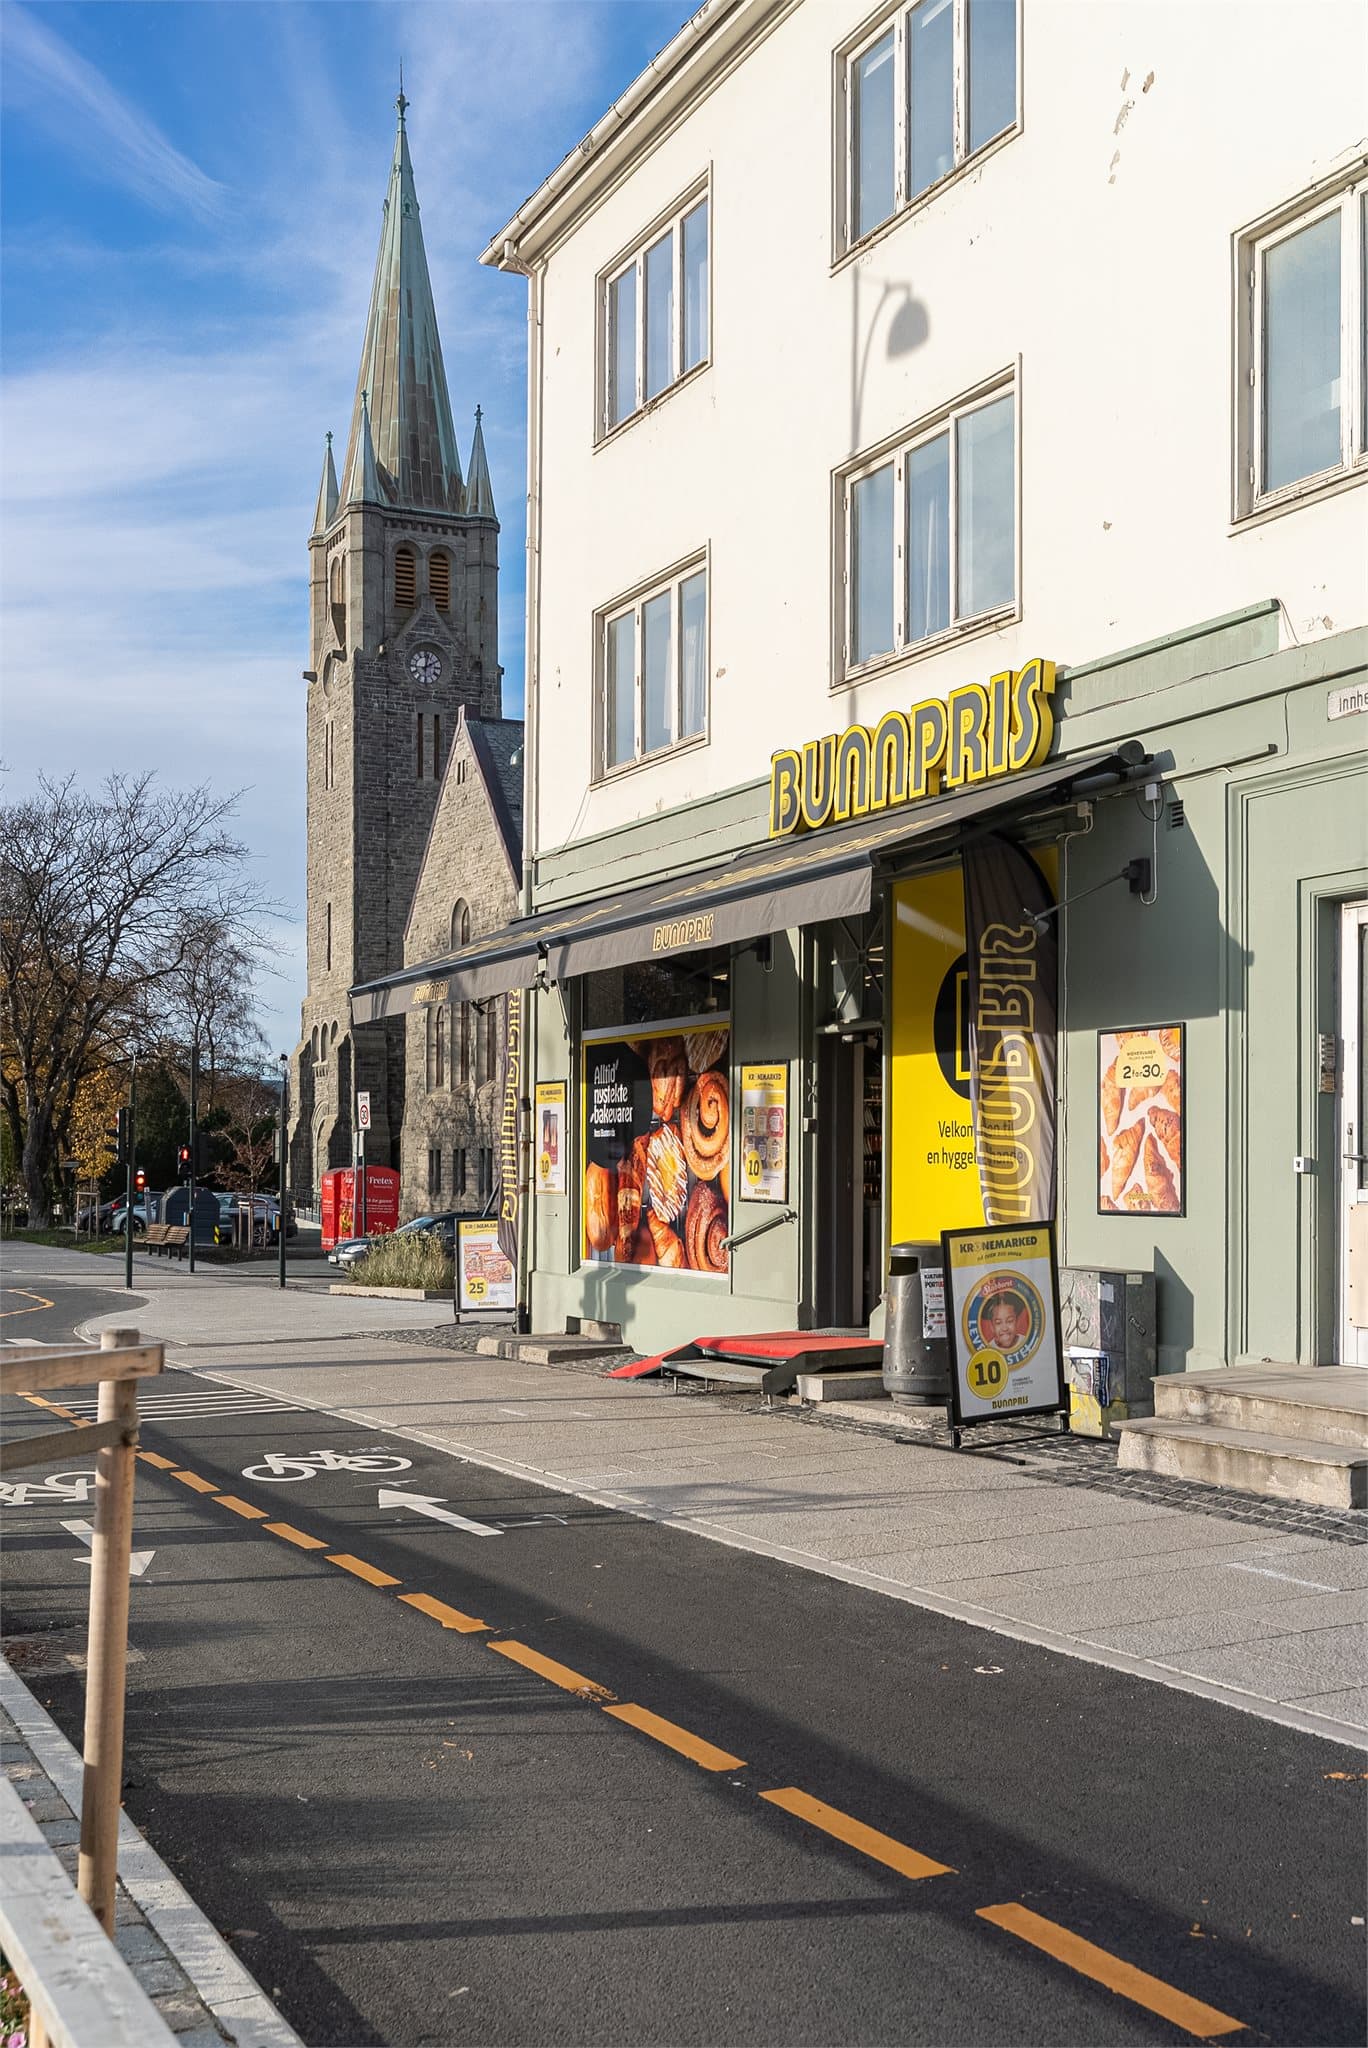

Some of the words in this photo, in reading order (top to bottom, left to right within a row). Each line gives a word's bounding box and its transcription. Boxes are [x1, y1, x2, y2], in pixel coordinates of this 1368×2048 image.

[770, 658, 1056, 838] BUNNPRIS
[652, 913, 714, 952] BUNNPRIS
[594, 1062, 617, 1084] Alltid
[1123, 1065, 1131, 1079] 2
[594, 1083, 628, 1104] nystekte
[592, 1104, 633, 1124] bakevarer
[541, 1160, 549, 1173] 10
[927, 1152, 939, 1164] en
[749, 1160, 760, 1176] 10
[469, 1282, 484, 1294] 25
[974, 1360, 1001, 1386] 10
[992, 1396, 1029, 1409] BUNNPRIS
